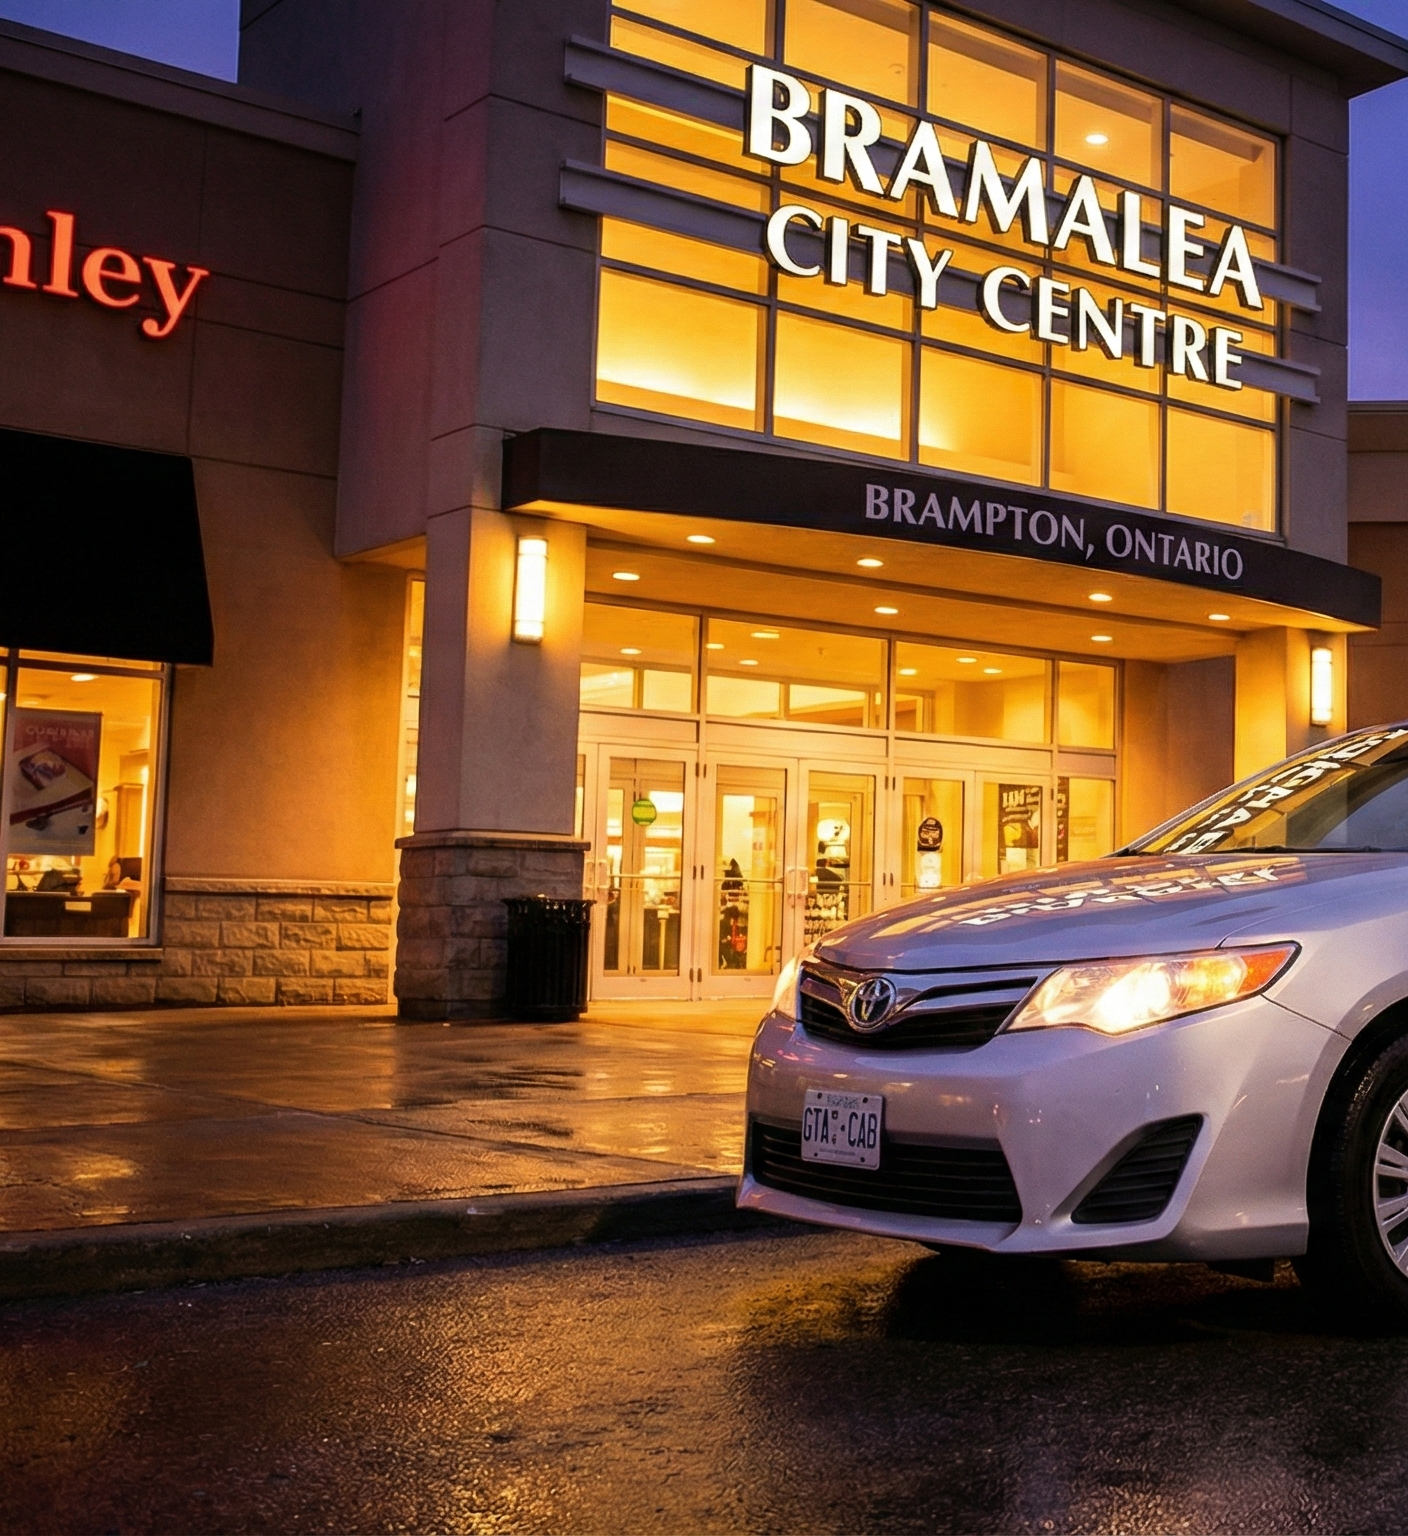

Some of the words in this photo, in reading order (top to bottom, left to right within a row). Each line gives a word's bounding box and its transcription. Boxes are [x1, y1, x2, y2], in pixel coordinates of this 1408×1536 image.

[745, 64, 1263, 309] BRAMALEA
[765, 204, 954, 310] CITY
[978, 266, 1243, 389] CENTRE
[865, 483, 1095, 560] BRAMPTON,
[1105, 524, 1243, 580] ONTARIO
